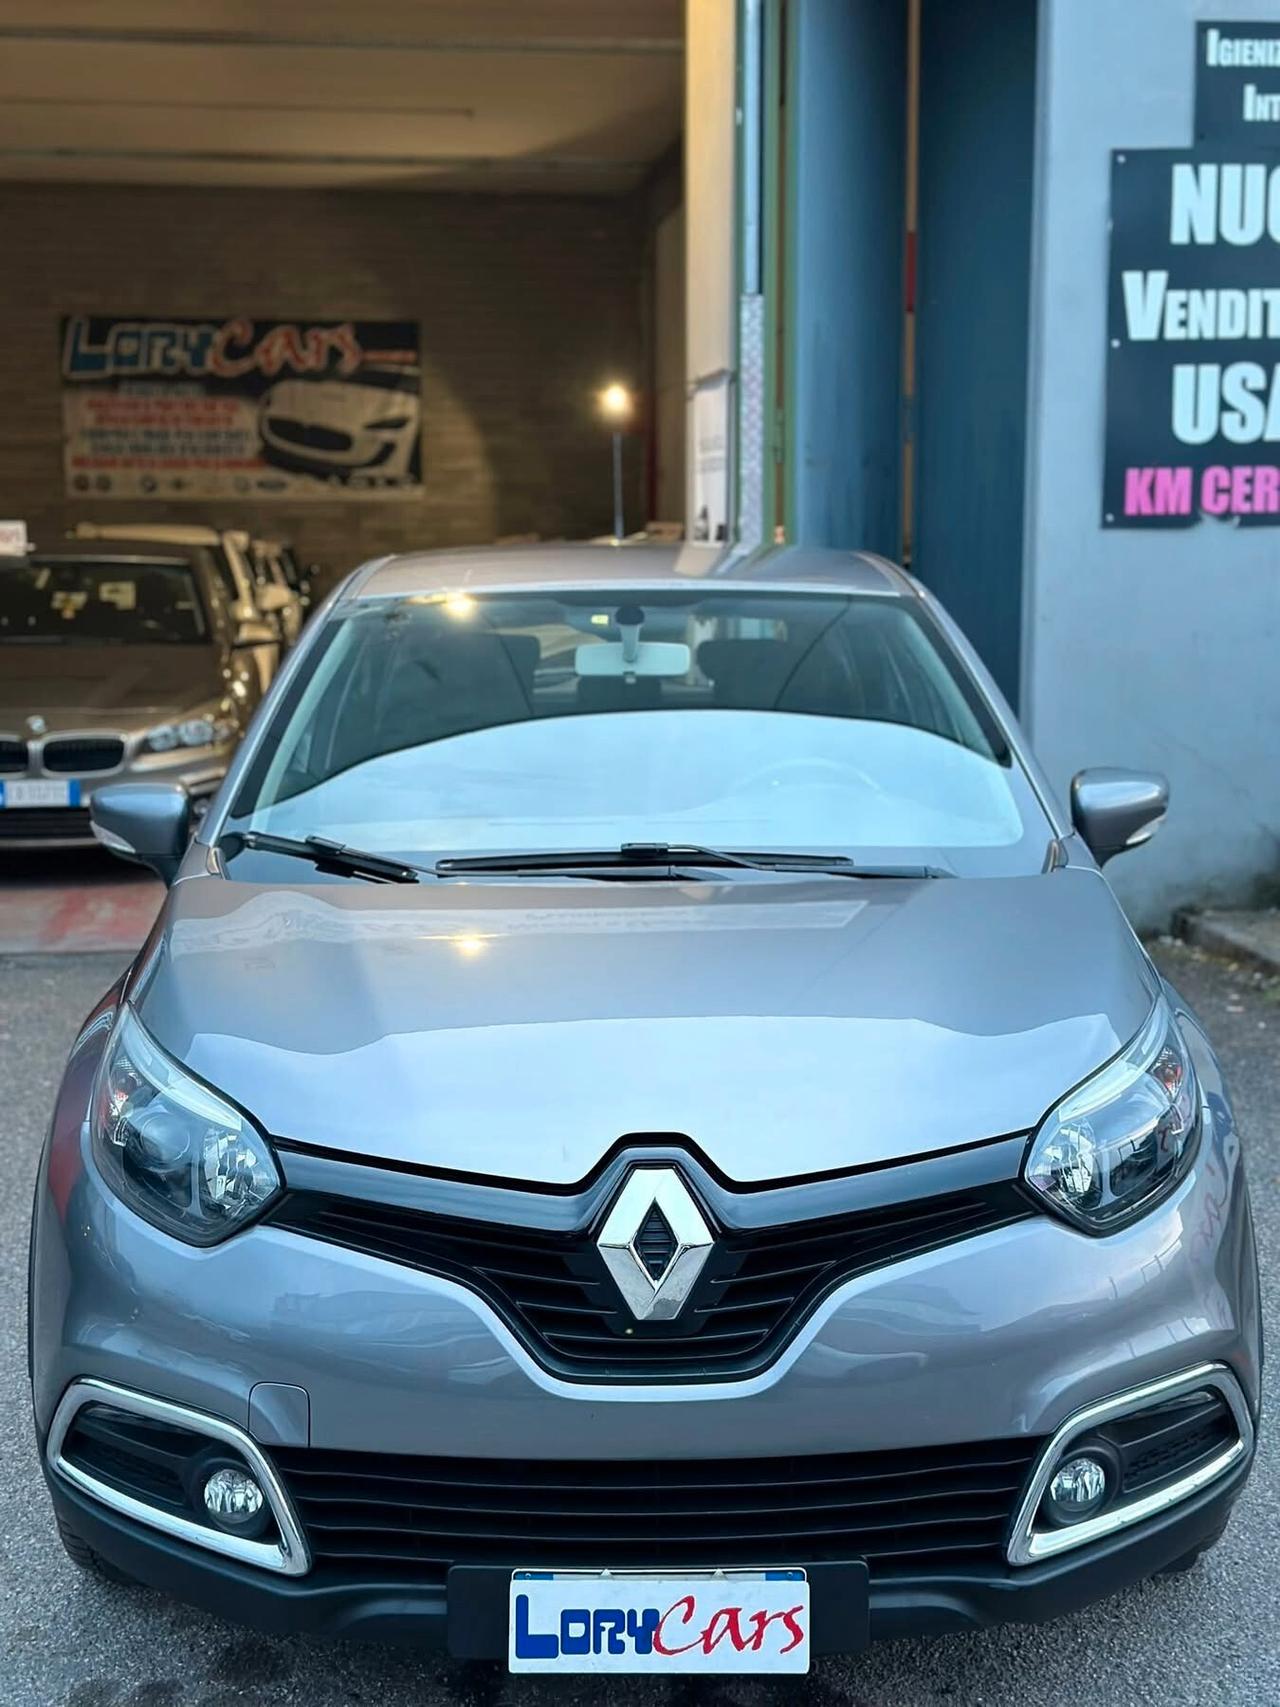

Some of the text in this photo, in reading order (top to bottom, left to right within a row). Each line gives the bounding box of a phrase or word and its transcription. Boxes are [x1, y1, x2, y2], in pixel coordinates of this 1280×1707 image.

[1170, 163, 1280, 246] NU
[1125, 466, 1280, 515] KM CER
